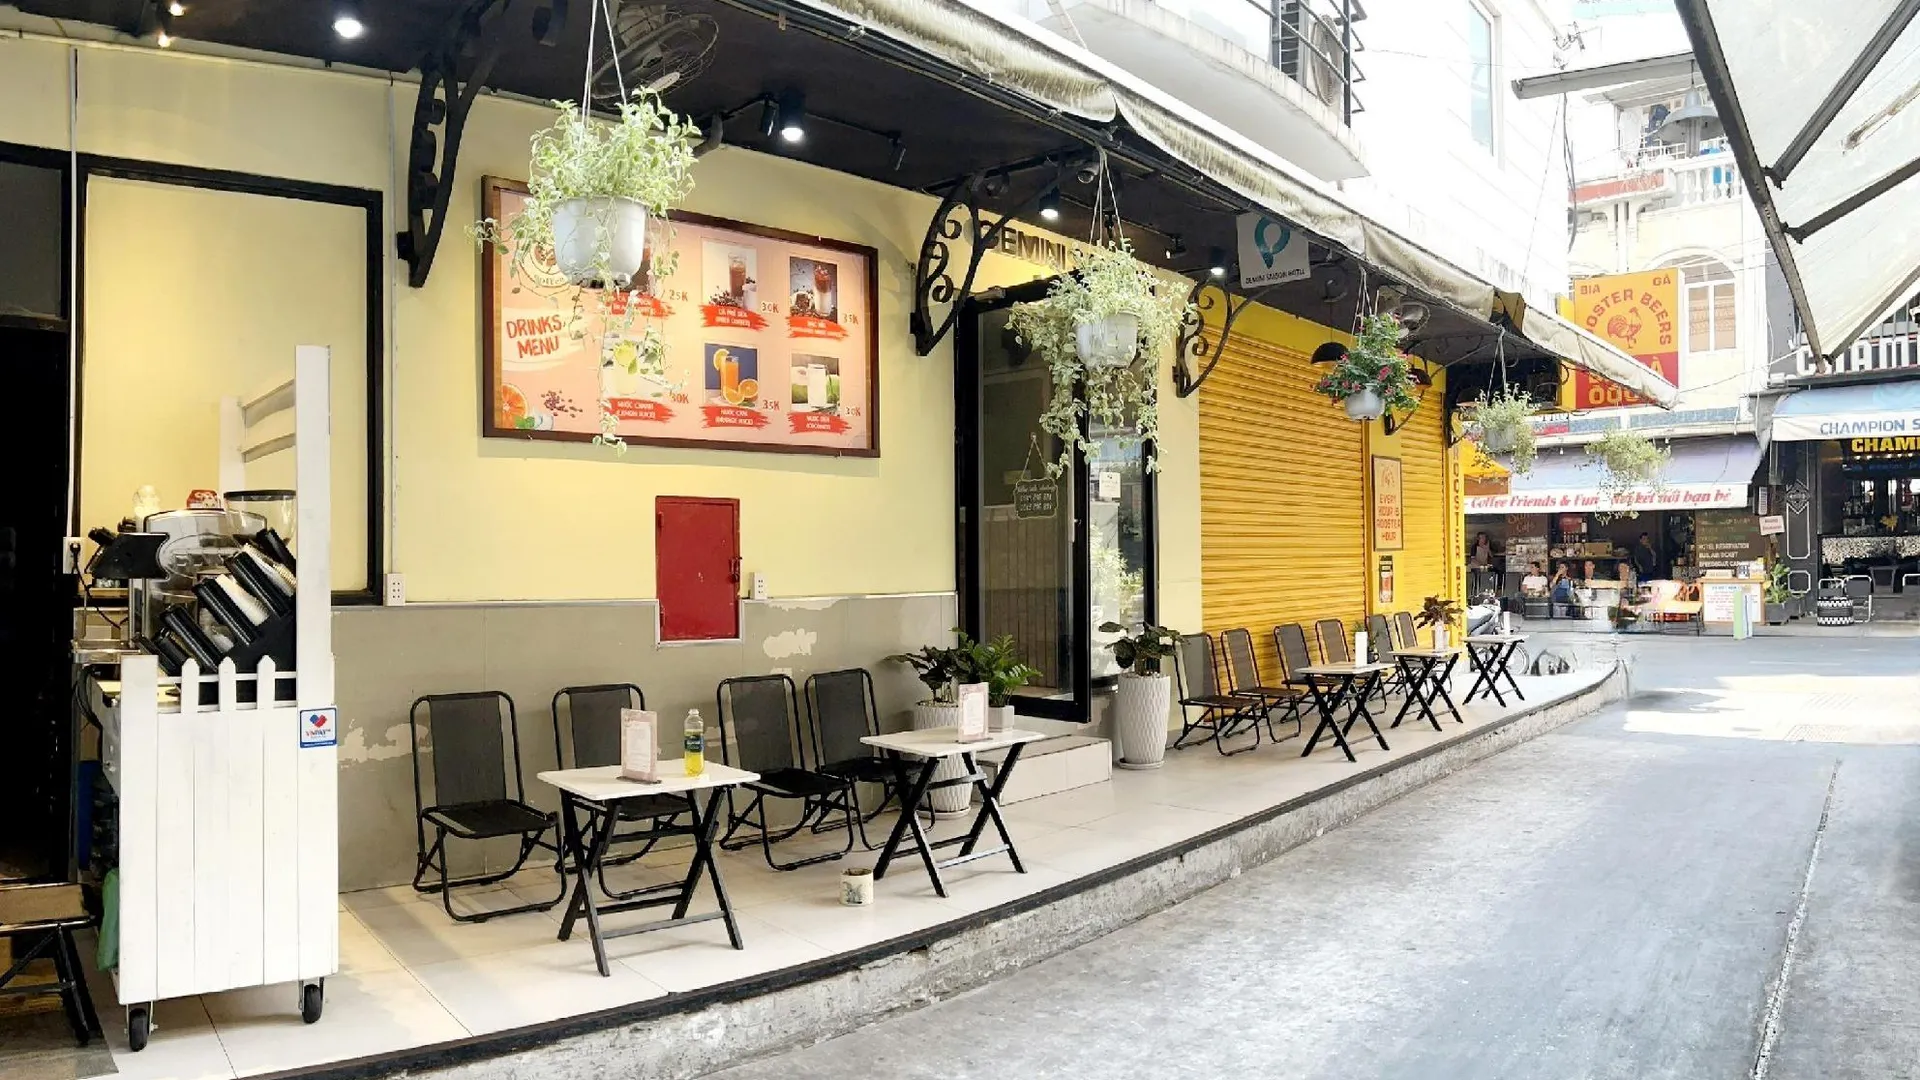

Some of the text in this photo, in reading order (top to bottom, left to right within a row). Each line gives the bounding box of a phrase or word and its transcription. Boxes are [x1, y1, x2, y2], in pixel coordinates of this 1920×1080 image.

[1580, 284, 1600, 295] BIA
[506, 314, 561, 338] DRINKS
[1585, 289, 1671, 345] OSTER BEERS
[517, 335, 560, 358] MENU
[1820, 419, 1906, 435] CHAMPION
[1509, 495, 1556, 506] Friends
[1560, 495, 1571, 506] &
